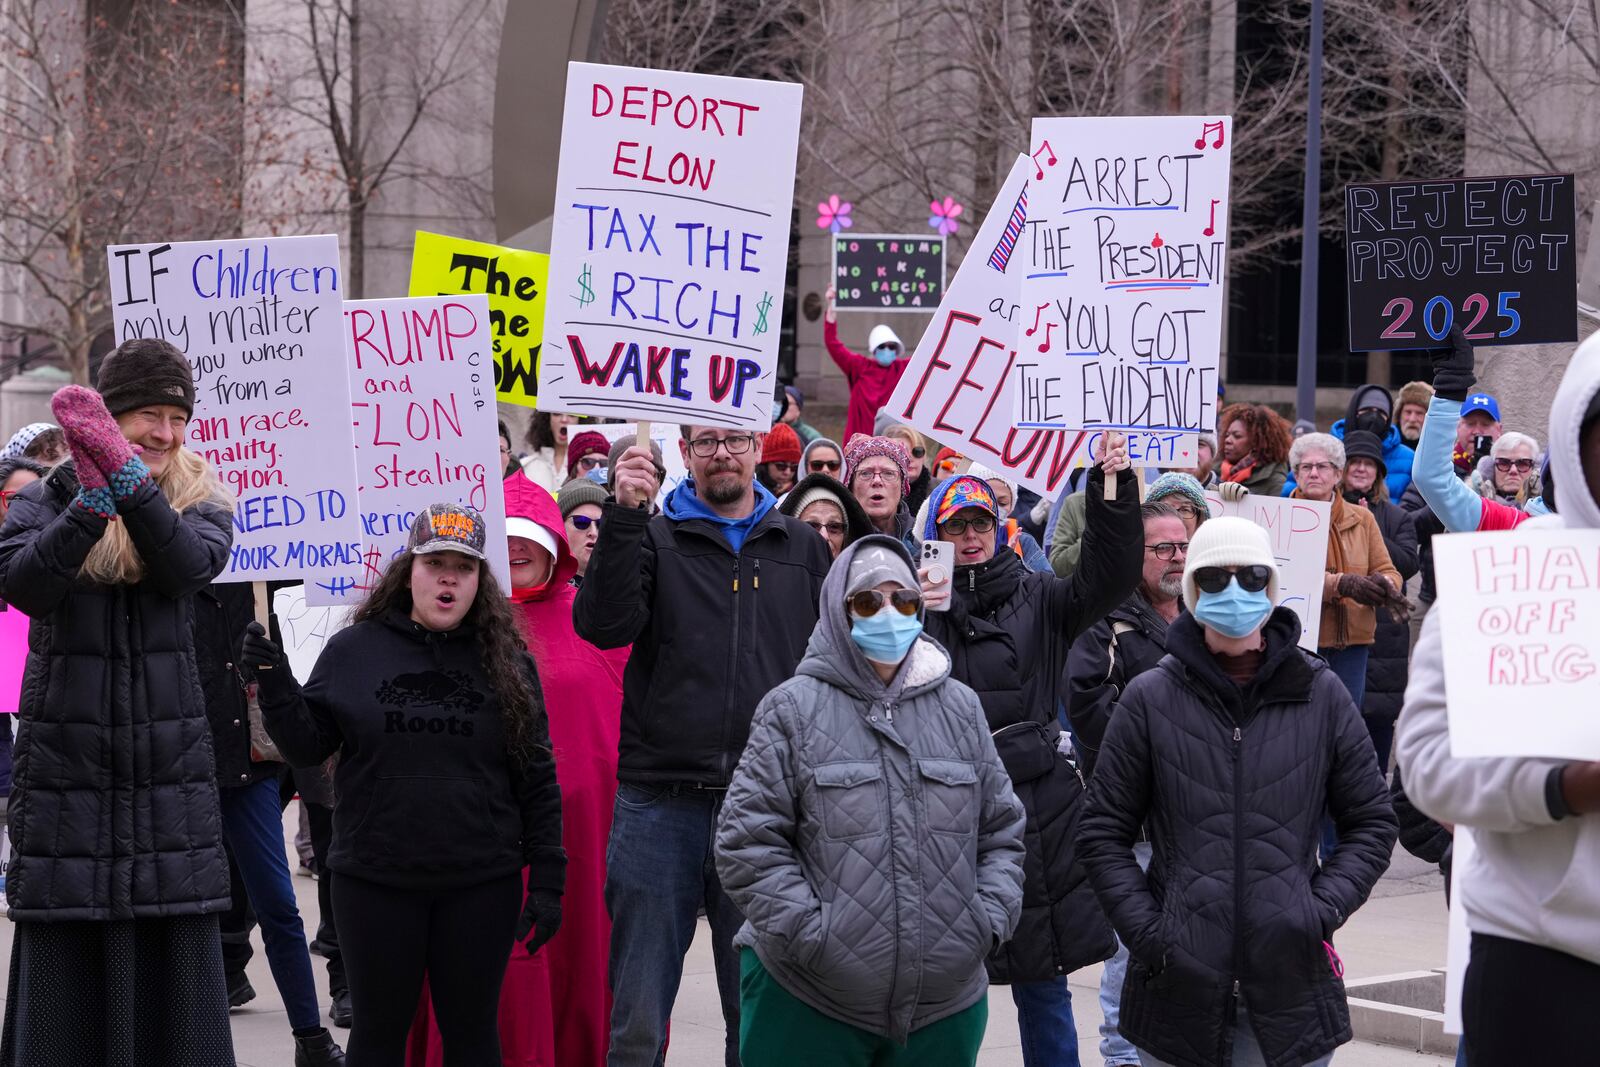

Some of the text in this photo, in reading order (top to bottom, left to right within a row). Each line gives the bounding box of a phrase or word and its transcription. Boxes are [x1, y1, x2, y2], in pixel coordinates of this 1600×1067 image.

[592, 84, 760, 137] DEPORT
[612, 141, 716, 191] ELON
[1062, 155, 1204, 213] ARREST
[1349, 177, 1565, 234] REJECT
[572, 203, 763, 273] TAX THE
[836, 241, 941, 255] NO TRUMP
[1026, 215, 1225, 284] THE PRESIDENT
[1351, 234, 1569, 282] PROJECT
[114, 243, 337, 306] IF Children
[449, 253, 539, 302] The
[837, 266, 861, 277] NO
[838, 281, 937, 300] NO FASCIST
[122, 294, 320, 353] only matter
[611, 271, 741, 339] RICH
[881, 293, 922, 306] USA
[1380, 291, 1521, 341] 2025
[344, 303, 478, 370] RUMP
[1056, 297, 1206, 365] YOU GOT
[189, 342, 303, 382] you when
[364, 375, 413, 395] and
[566, 335, 762, 408] WAKE UP
[210, 374, 268, 405] from
[274, 378, 292, 396] a
[901, 309, 1088, 492] FELON
[1016, 363, 1063, 422] THE
[240, 407, 310, 436] race.
[373, 452, 488, 513] stealing
[232, 489, 346, 534] NEED TO
[431, 512, 475, 533] HARRIS
[437, 527, 468, 541] WALZ
[230, 544, 278, 573] YOUR
[284, 540, 363, 570] MORALS
[1473, 545, 1600, 595] HA
[1478, 599, 1576, 637] OFF
[1488, 643, 1600, 686] RIG
[384, 710, 475, 738] Roots
